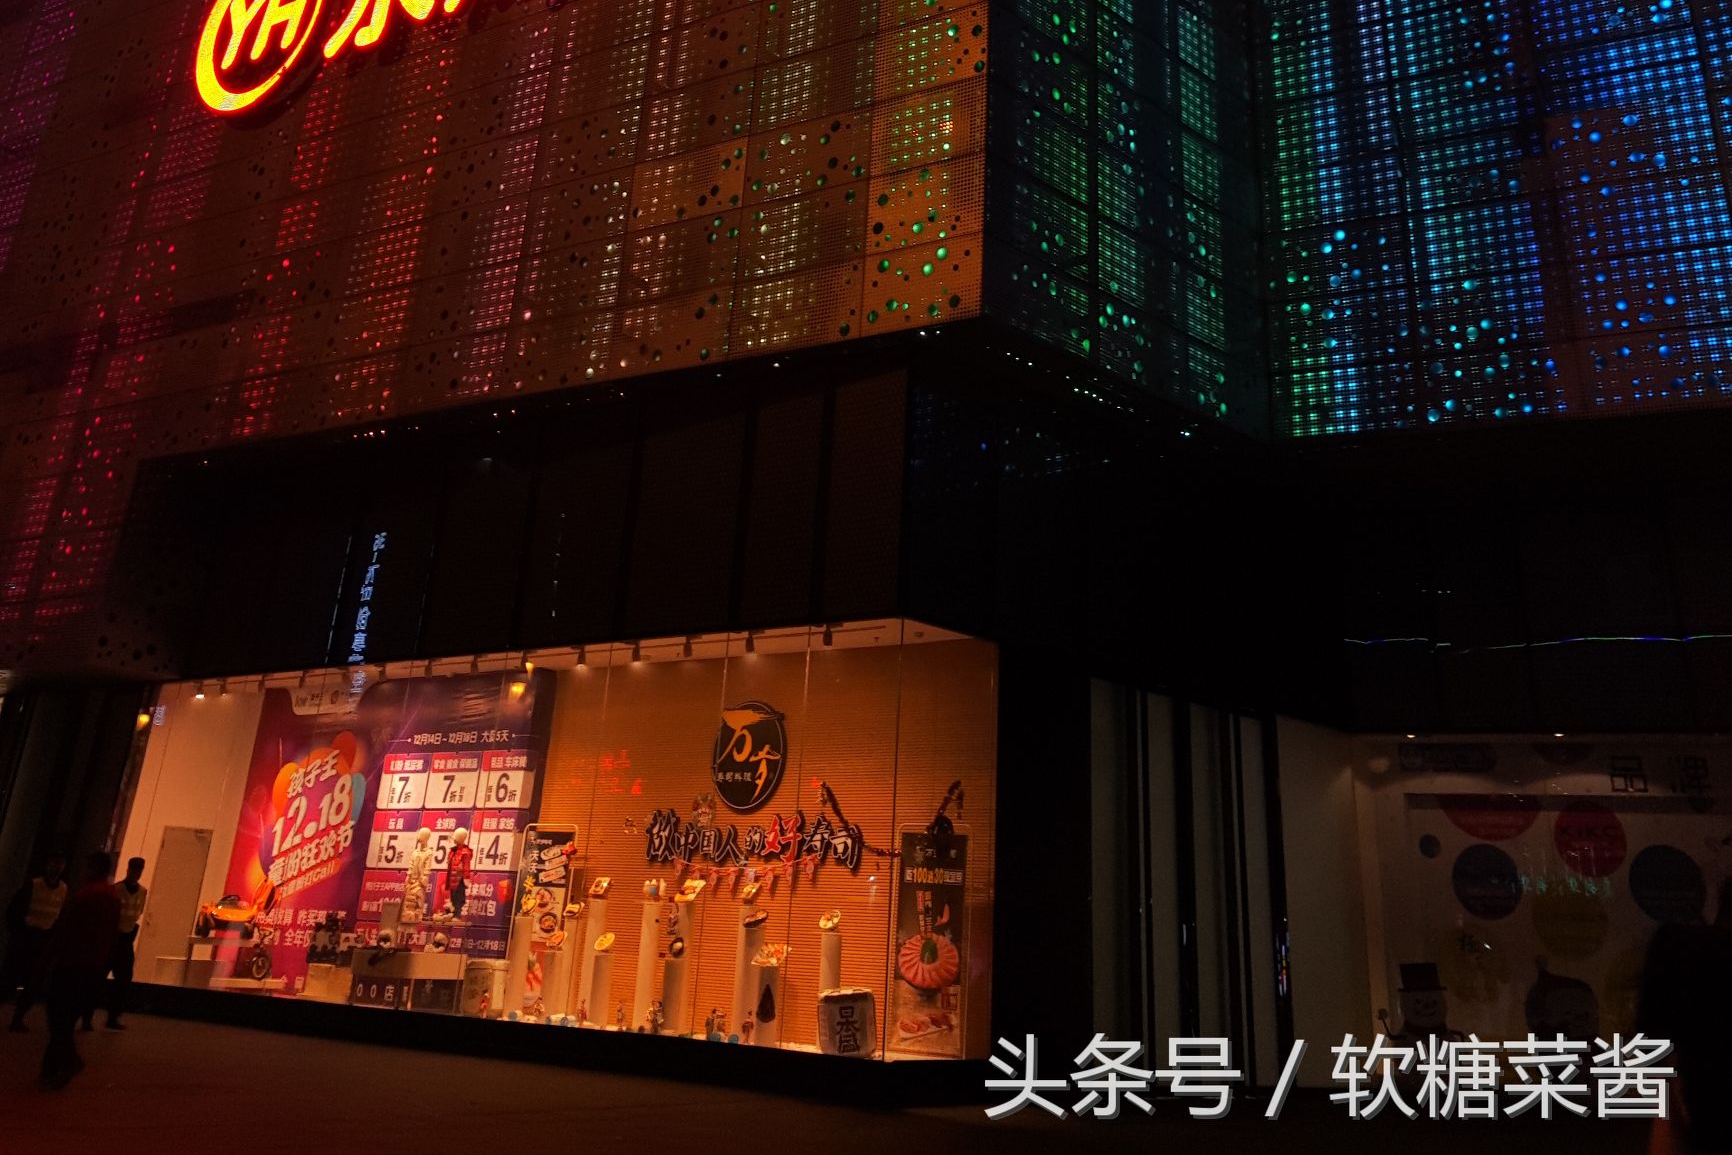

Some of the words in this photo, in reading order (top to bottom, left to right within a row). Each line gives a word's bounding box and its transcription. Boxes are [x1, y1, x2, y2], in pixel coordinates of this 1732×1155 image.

[287, 750, 340, 798] 孩子王
[272, 773, 352, 856] 12.18
[645, 809, 860, 868] 做中国人的好寿司
